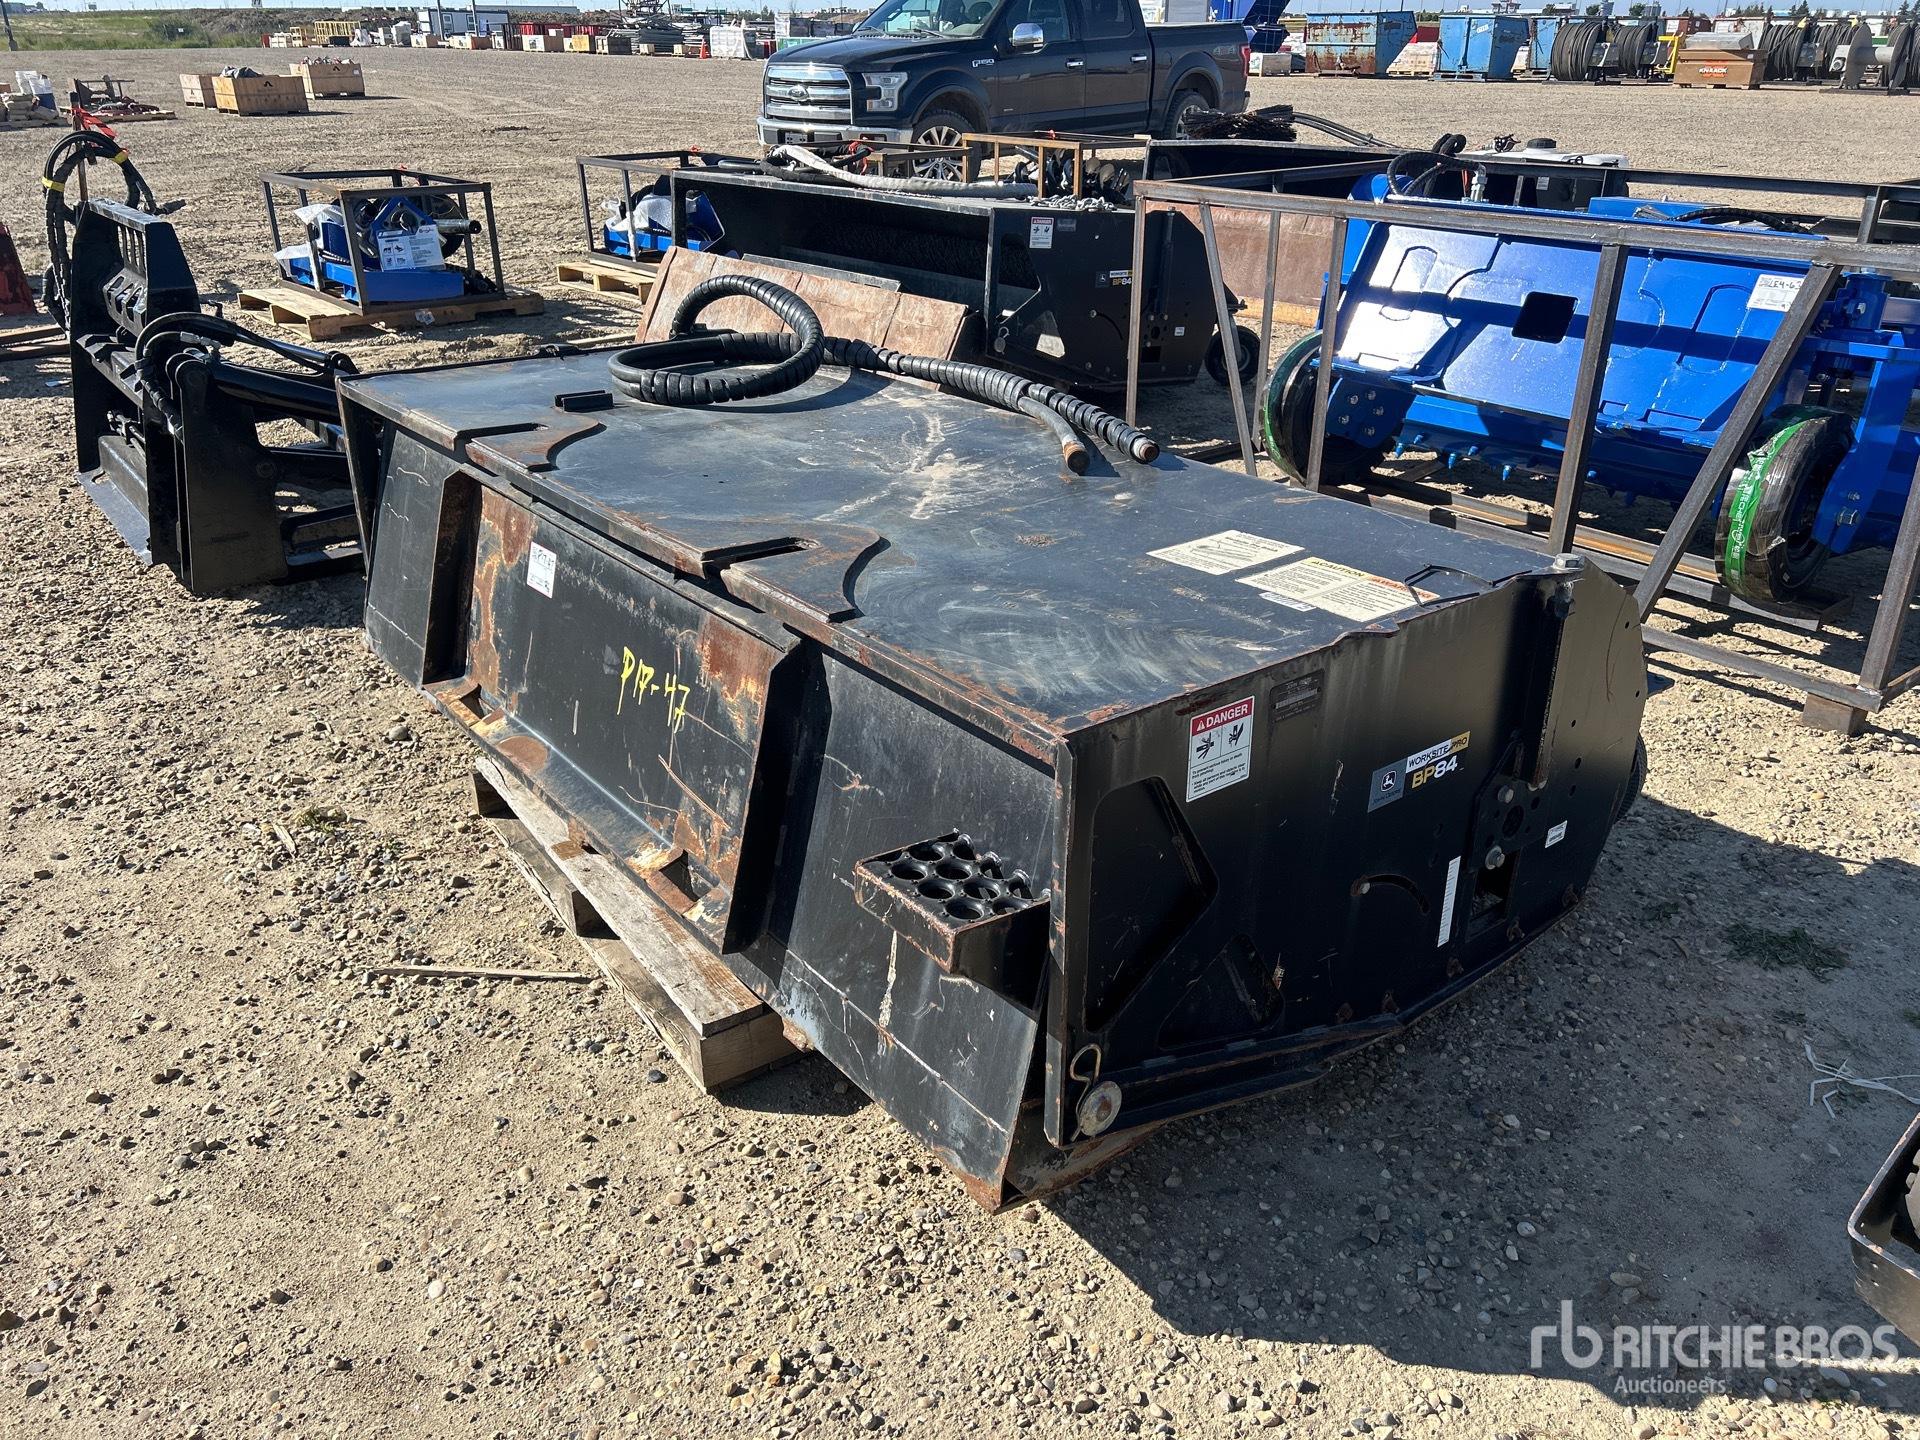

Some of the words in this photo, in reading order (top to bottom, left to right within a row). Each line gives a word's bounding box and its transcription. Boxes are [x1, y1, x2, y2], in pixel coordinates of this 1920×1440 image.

[1112, 277, 1132, 286] BP84
[1319, 562, 1365, 577] CAUTION
[1206, 703, 1248, 728] DANGER
[1408, 745, 1450, 768] WORKSITE
[1451, 736, 1468, 750] PRO
[1411, 755, 1458, 789] BP84
